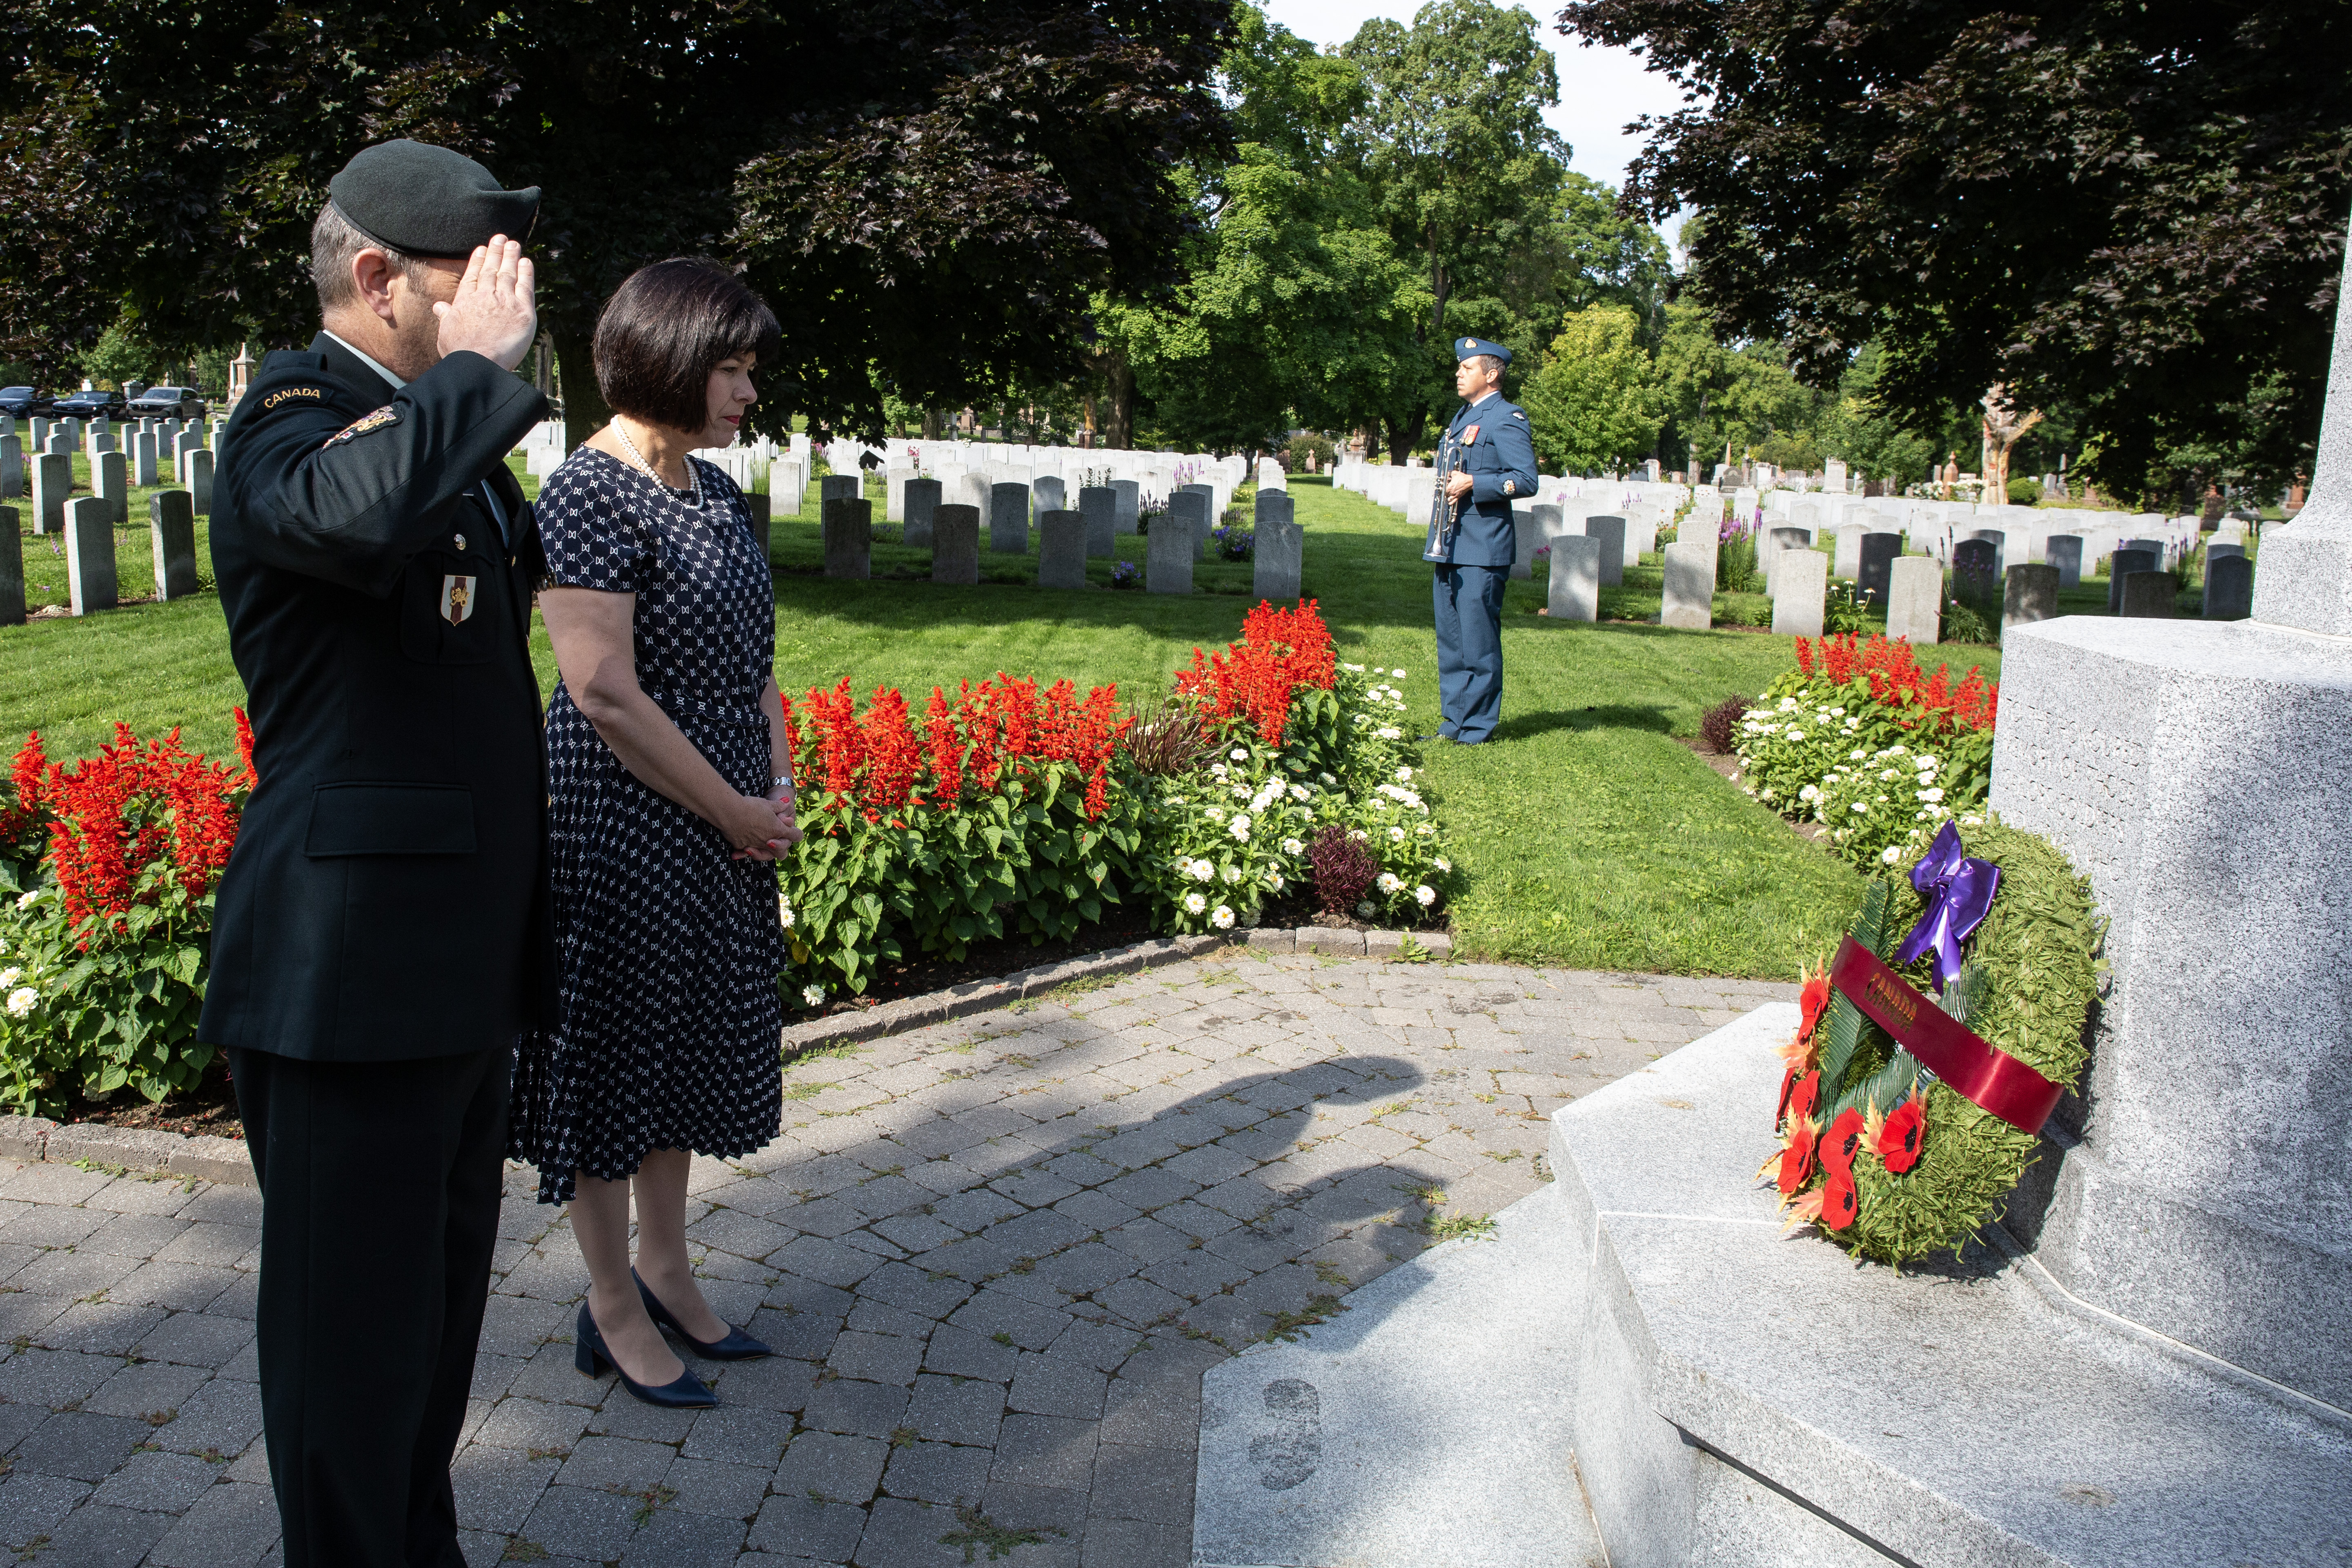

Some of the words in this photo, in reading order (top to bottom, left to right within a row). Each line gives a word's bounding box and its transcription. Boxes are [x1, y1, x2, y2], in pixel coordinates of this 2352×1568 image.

[265, 388, 320, 408] CANADA
[2058, 717, 2141, 768] HONOURED
[1864, 972, 1918, 1033] CANADA
